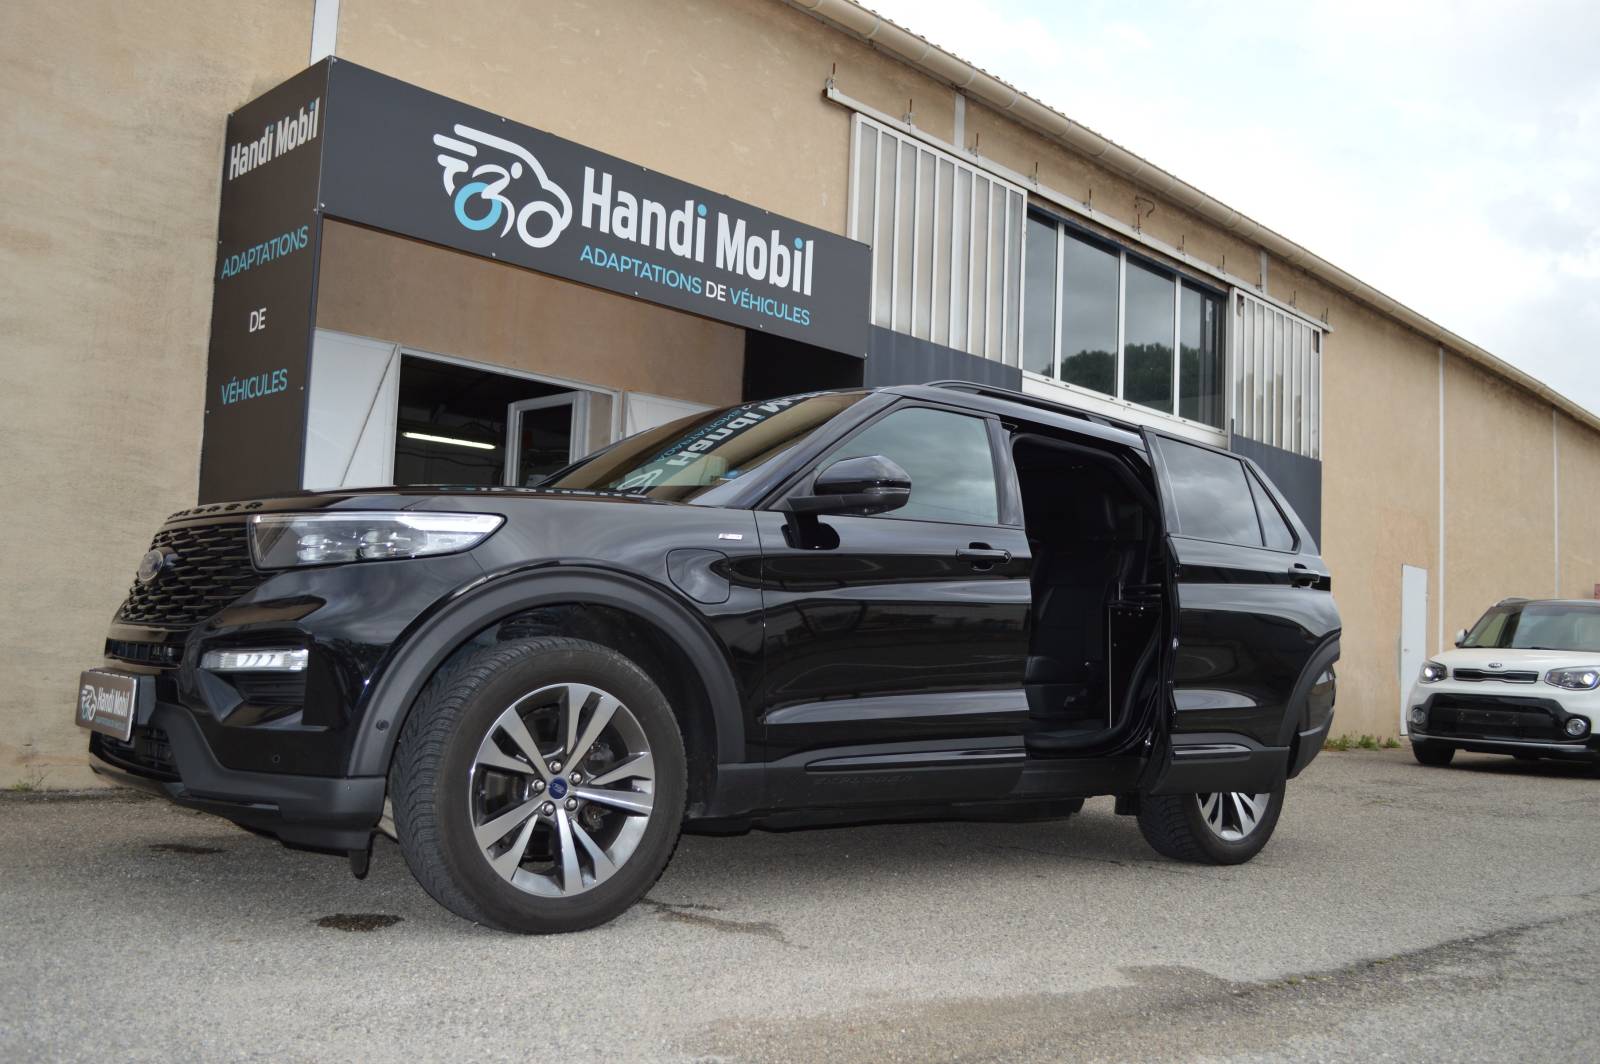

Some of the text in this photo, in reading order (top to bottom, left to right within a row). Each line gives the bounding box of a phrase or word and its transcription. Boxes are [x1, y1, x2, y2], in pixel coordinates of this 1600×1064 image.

[229, 96, 320, 181] Handi Mobil
[221, 225, 309, 279] ADAPTATIONS
[582, 165, 814, 297] Handi Mobil
[580, 244, 810, 326] ADAPTATIONS DE VÉHICULES
[249, 307, 267, 333] DE
[221, 368, 288, 406] VÉHICULES
